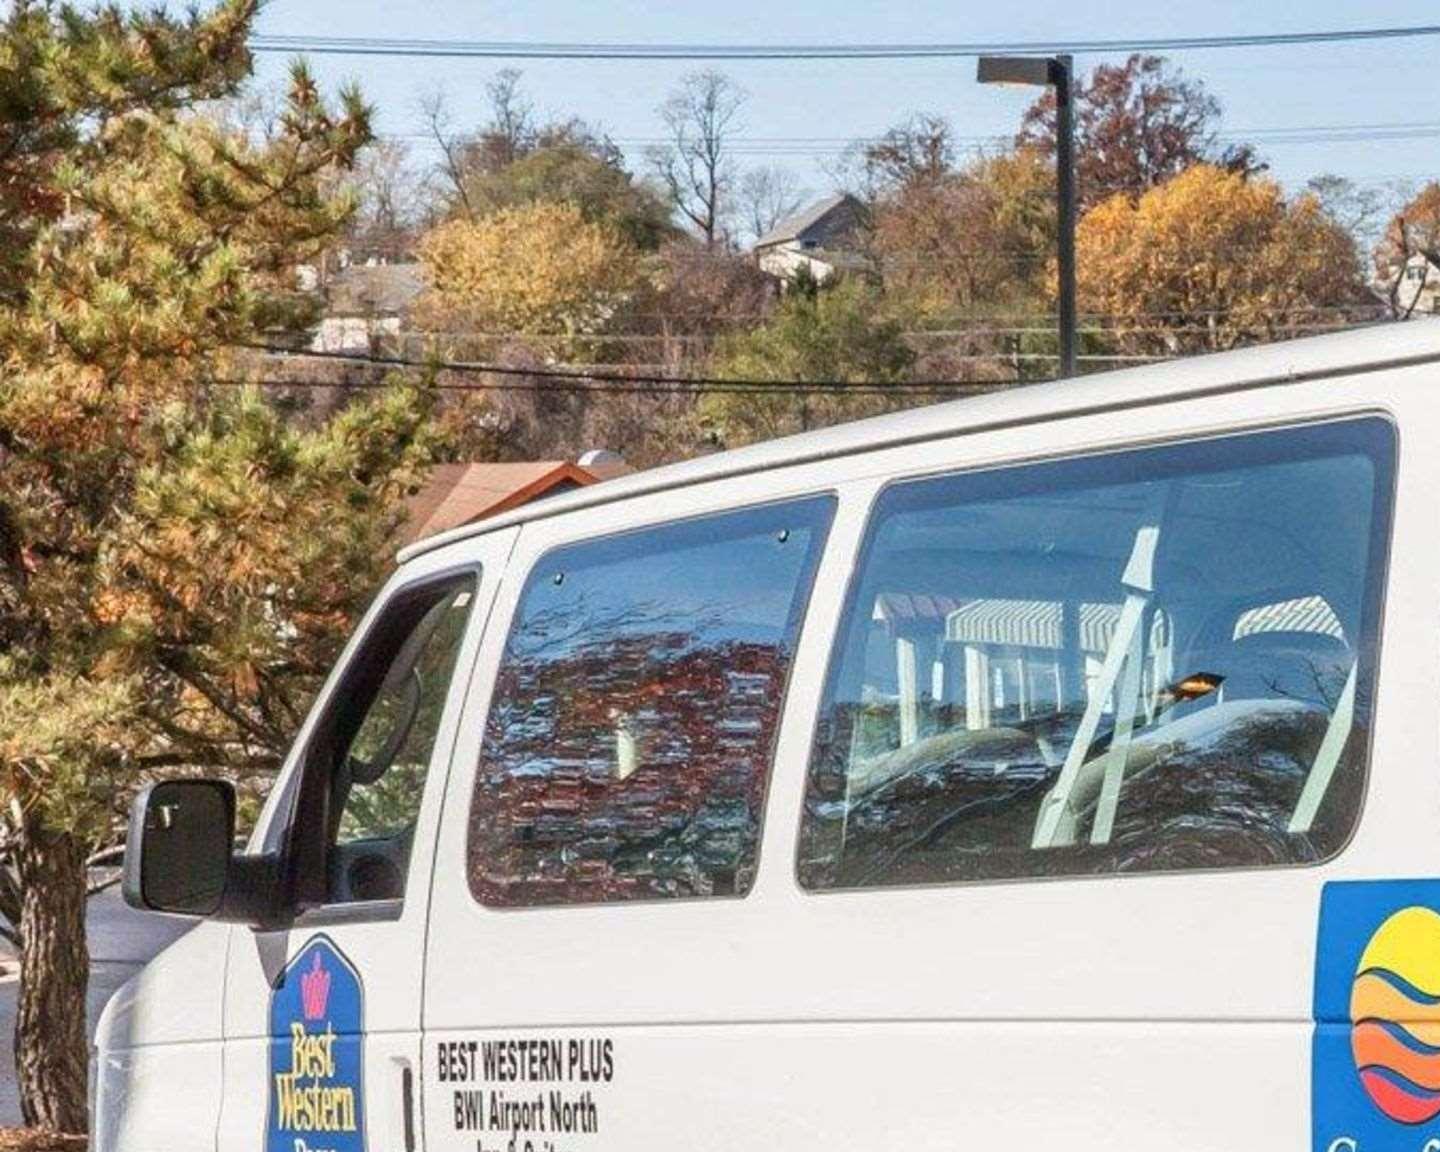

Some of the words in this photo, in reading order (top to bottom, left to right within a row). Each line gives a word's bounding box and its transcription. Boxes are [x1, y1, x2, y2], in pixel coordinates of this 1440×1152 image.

[291, 1021, 337, 1079] Best
[437, 1042, 478, 1082] BEST
[482, 1041, 563, 1082] WESTERN
[568, 1039, 613, 1082] PLUS
[275, 1072, 356, 1132] Western
[454, 1091, 484, 1131] BWI
[488, 1092, 544, 1142] Airport
[549, 1095, 599, 1133] North
